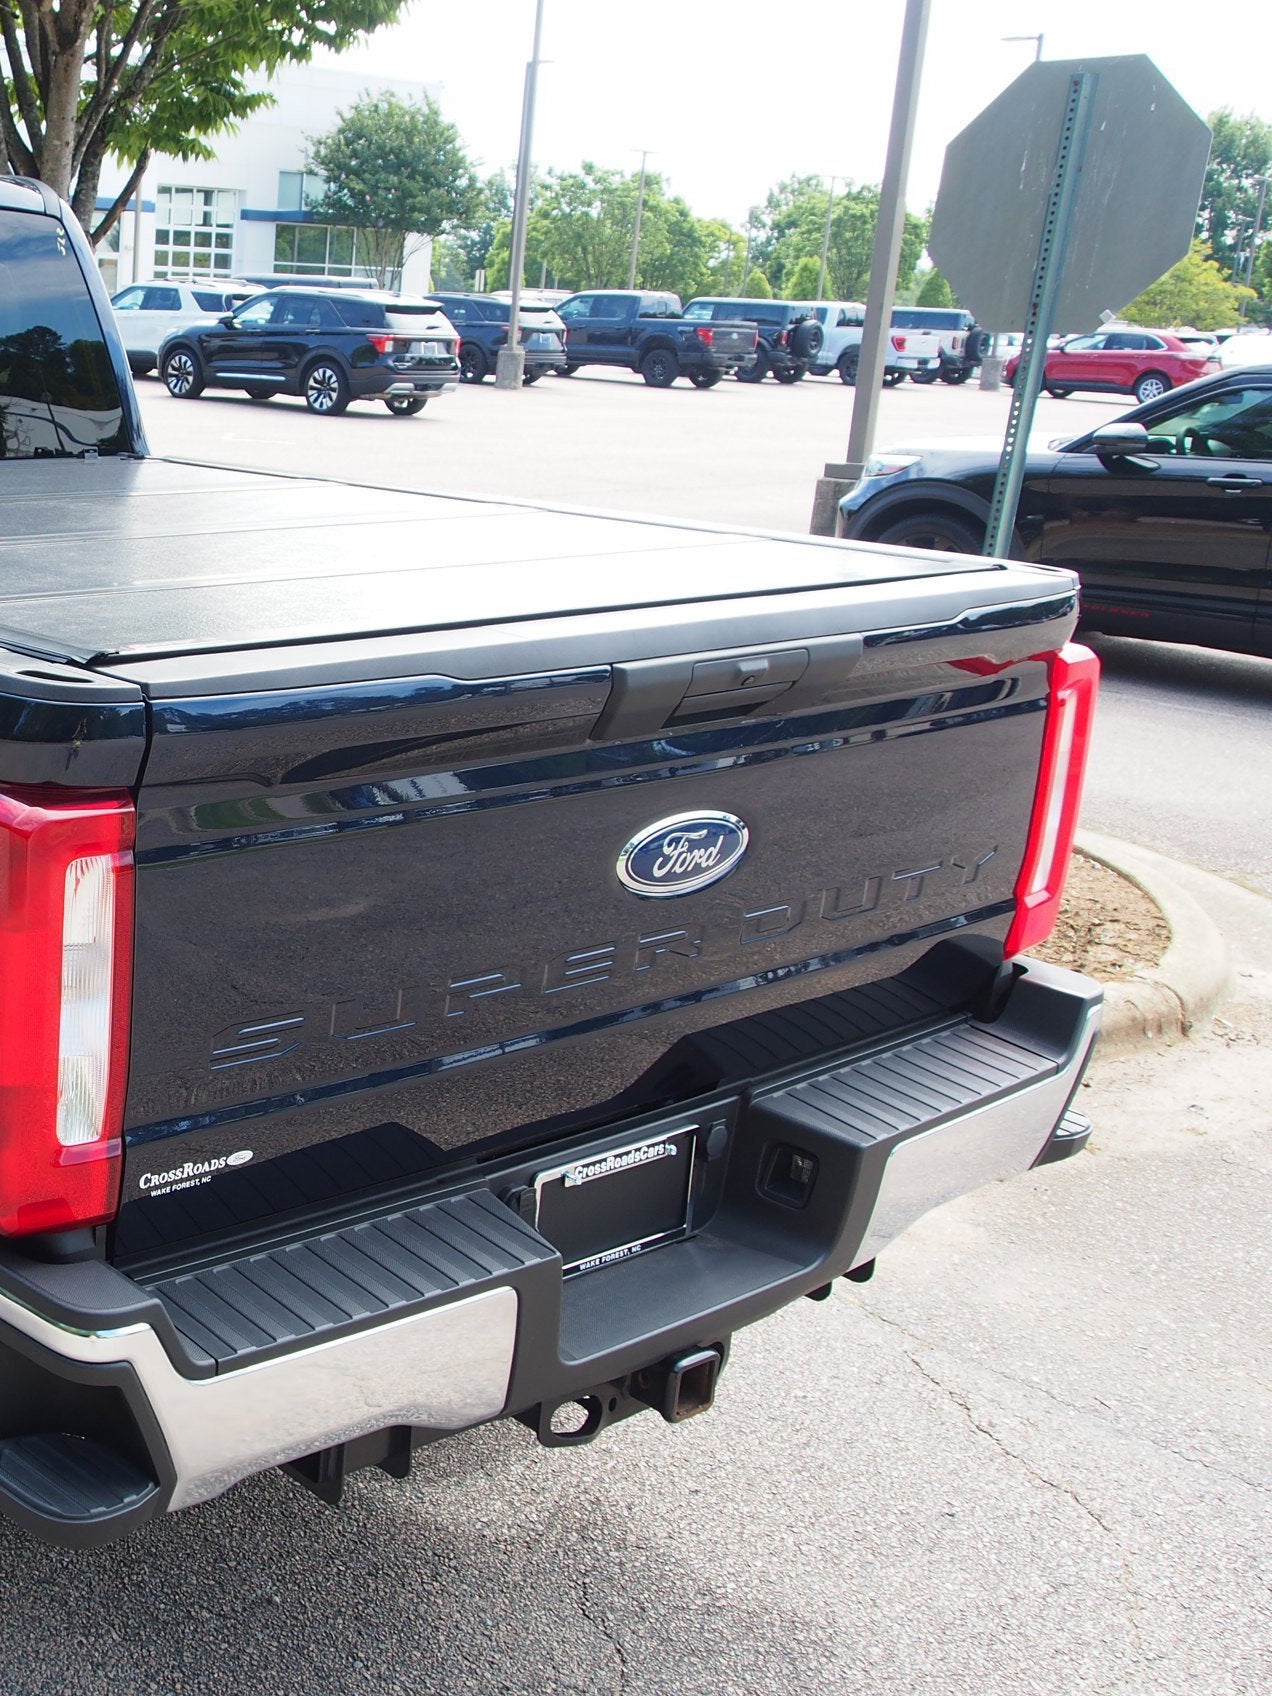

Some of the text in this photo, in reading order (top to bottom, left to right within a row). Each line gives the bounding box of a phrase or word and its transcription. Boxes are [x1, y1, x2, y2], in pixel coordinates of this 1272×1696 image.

[652, 828, 724, 878] Ford
[209, 844, 999, 1071] SUPER DUTY
[150, 1175, 212, 1197] WAKE FOREST, NC
[579, 1244, 642, 1271] WAKE FOREST, NC
